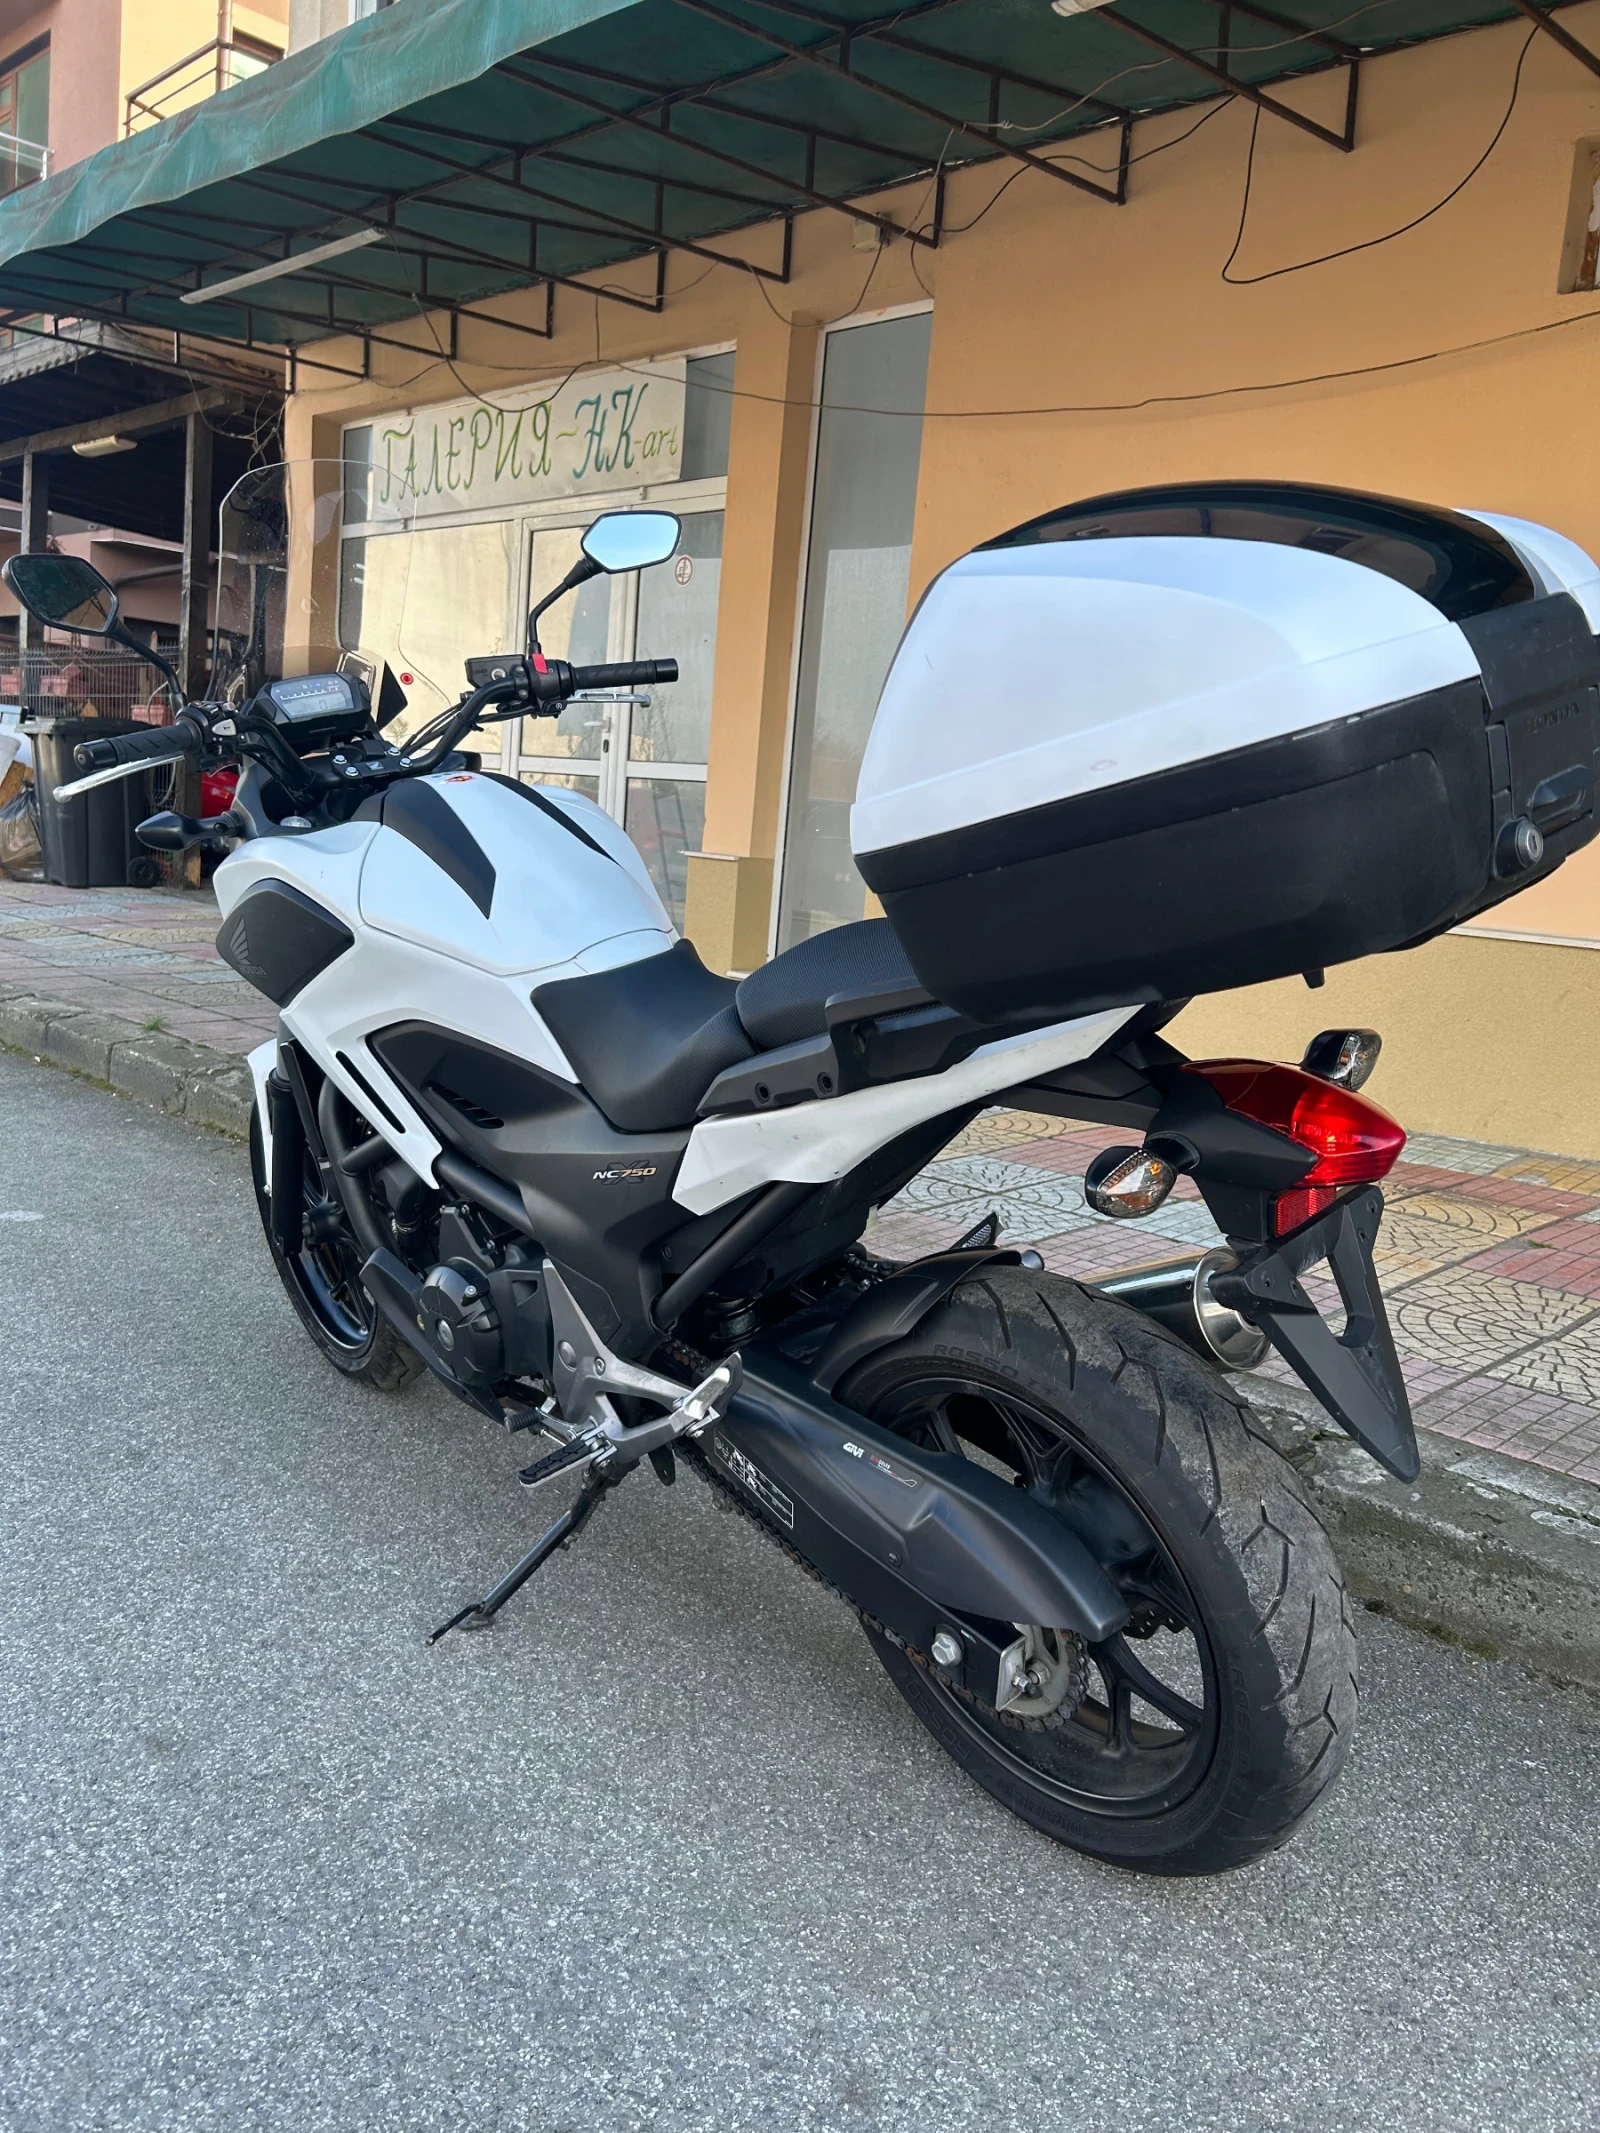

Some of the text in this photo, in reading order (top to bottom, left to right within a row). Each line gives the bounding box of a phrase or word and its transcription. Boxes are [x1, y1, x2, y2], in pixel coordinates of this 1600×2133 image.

[592, 1167, 657, 1180] NC750
[933, 1343, 1019, 1379] ROSSO
[842, 1441, 866, 1460] GIVI
[905, 1681, 1085, 1838] DIABLO ROSSO
